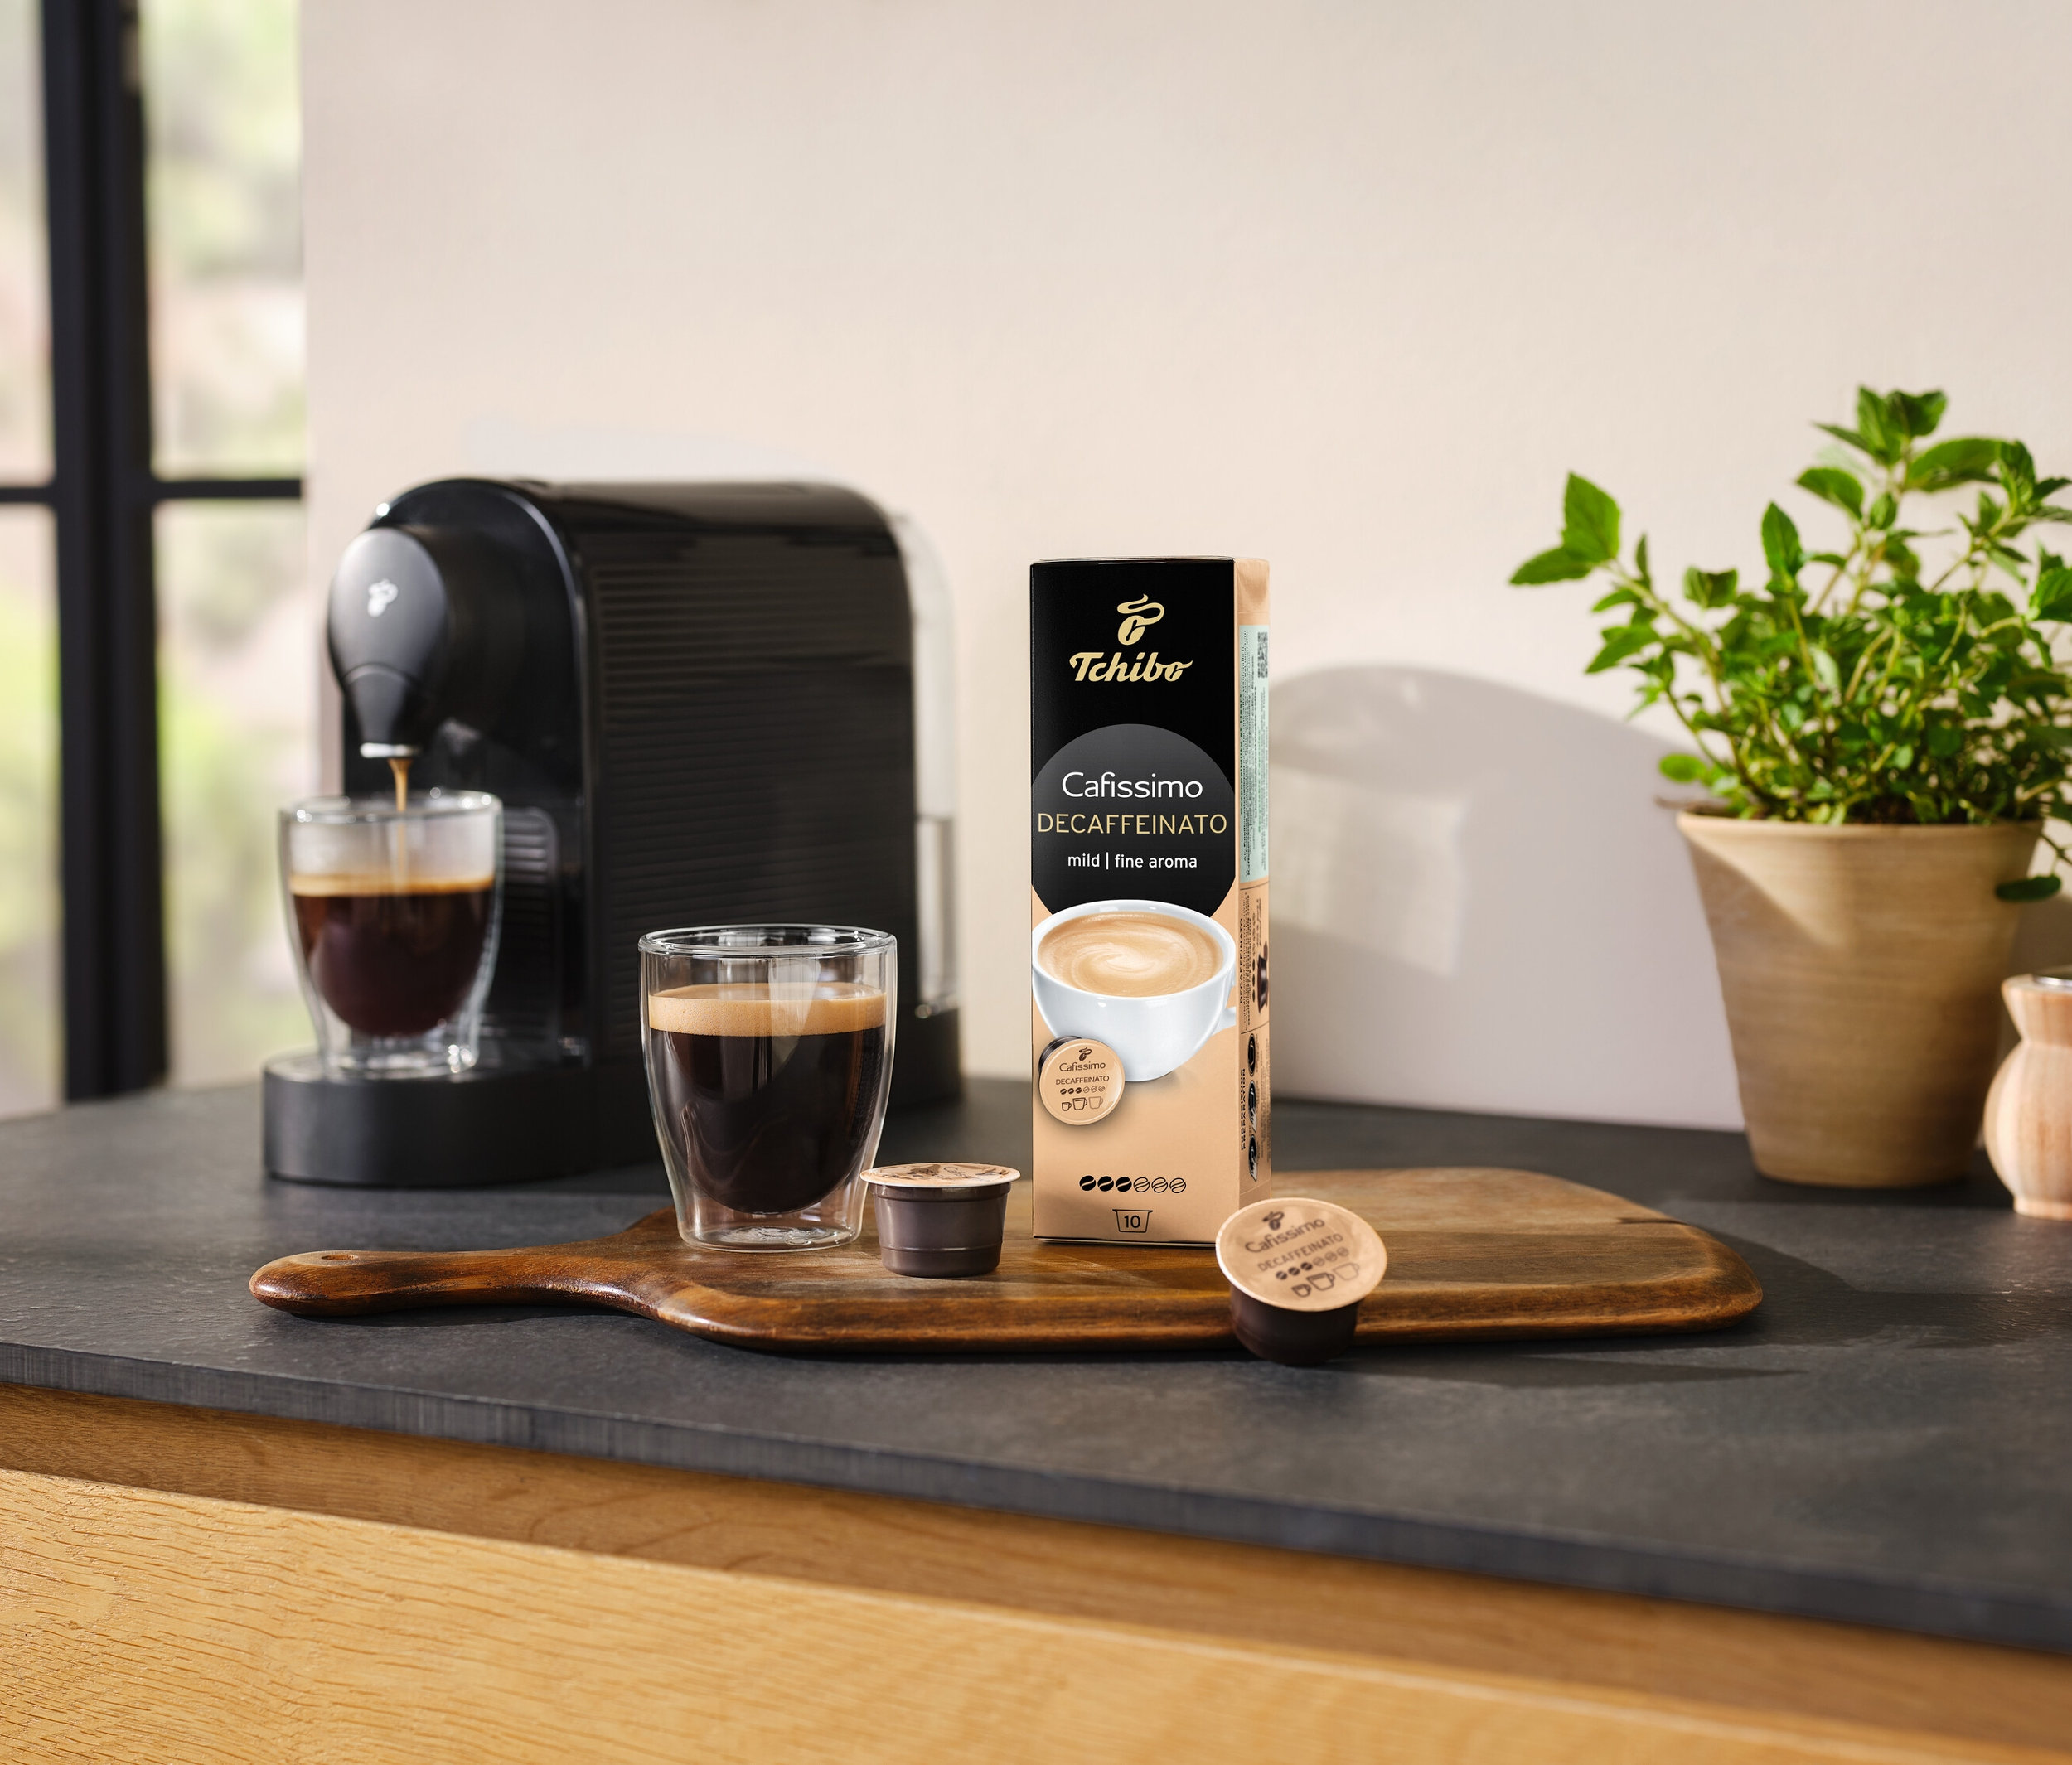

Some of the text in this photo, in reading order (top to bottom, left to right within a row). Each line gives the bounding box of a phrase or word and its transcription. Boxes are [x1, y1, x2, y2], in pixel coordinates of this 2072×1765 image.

[1069, 651, 1193, 682] Tchibo
[1062, 771, 1203, 798] Cafissimo
[1038, 813, 1227, 834] DECAFFEINATO
[1067, 853, 1100, 868] mild
[1115, 853, 1144, 868] fine
[1148, 856, 1198, 868] aroma
[1059, 1061, 1106, 1072] Cafissimo
[1055, 1075, 1110, 1086] DECAFFEINATO
[1124, 1215, 1141, 1228] 10
[1245, 1218, 1325, 1254] Cafissimo
[1257, 1233, 1343, 1272] DECAFFEINATO
